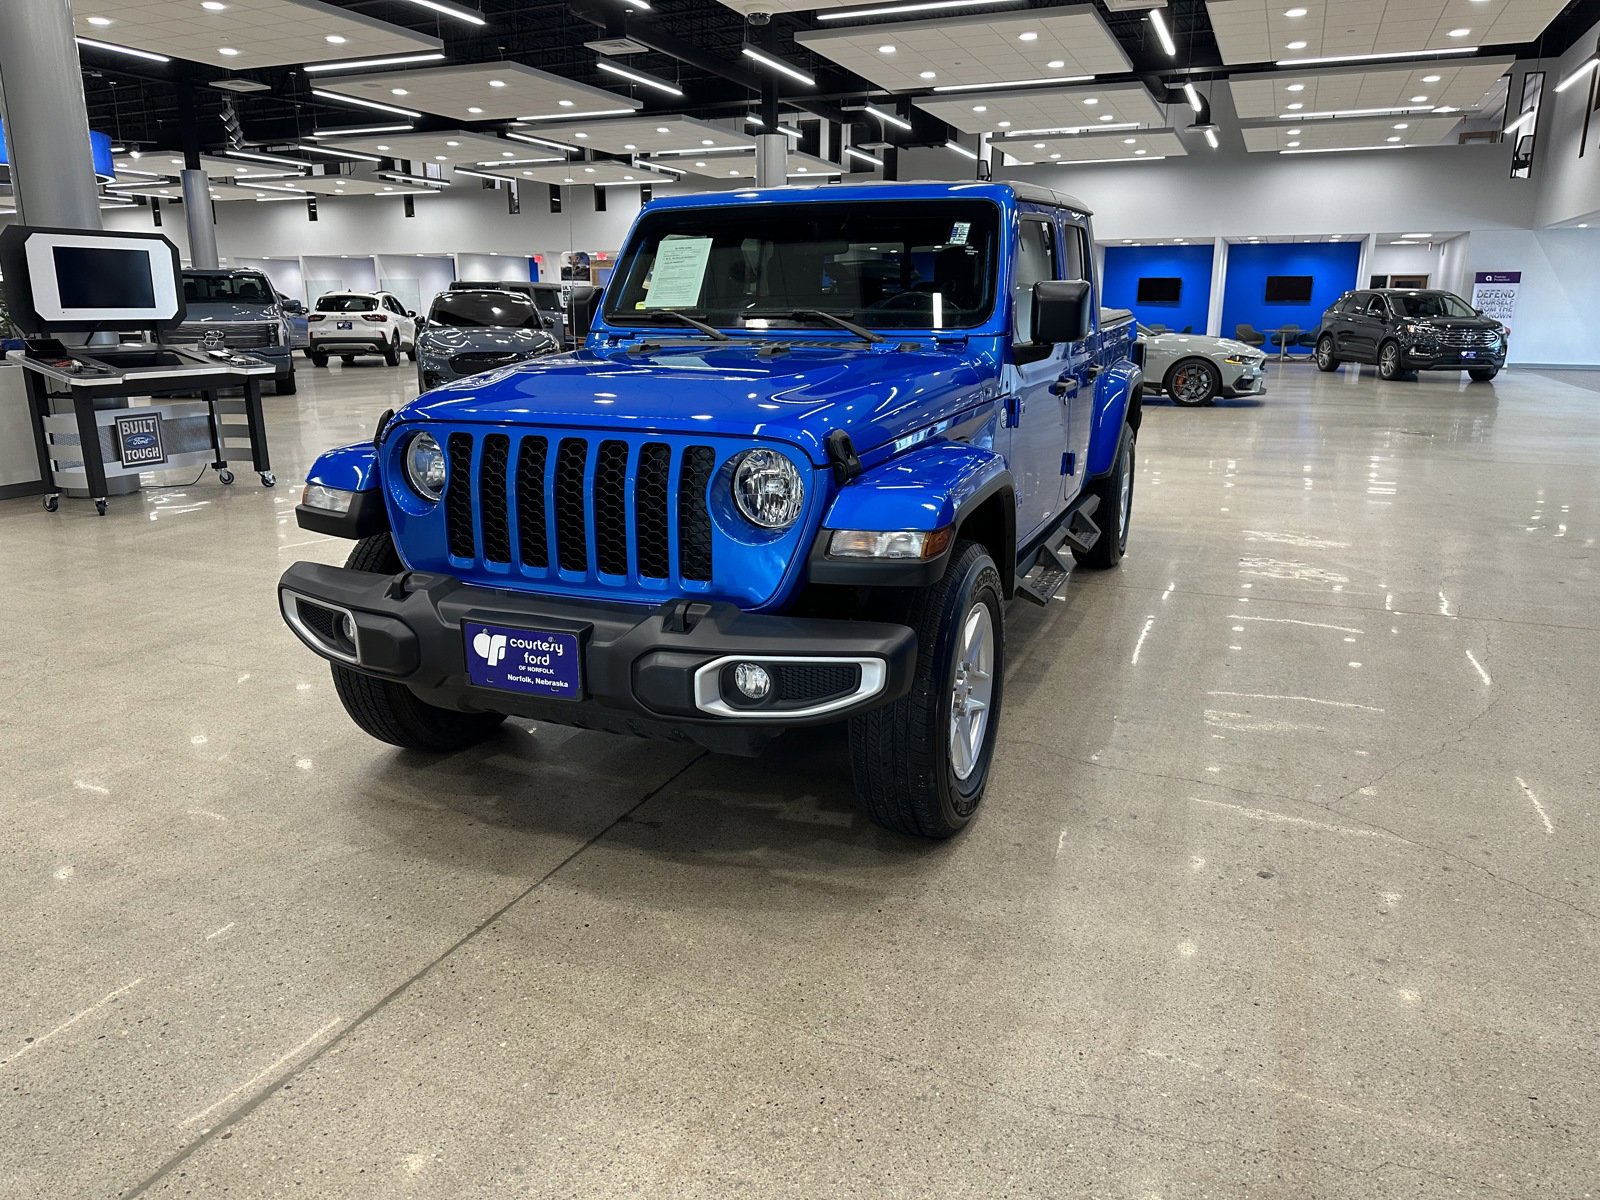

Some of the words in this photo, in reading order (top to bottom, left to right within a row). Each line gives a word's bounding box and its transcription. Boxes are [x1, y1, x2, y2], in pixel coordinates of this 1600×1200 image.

[1476, 290, 1515, 298] DEFEND
[120, 420, 154, 435] BUILT
[126, 446, 159, 461] TOUGH
[510, 638, 564, 656] courtesy
[524, 652, 550, 666] ford
[527, 666, 555, 674] NORFOLK
[507, 674, 534, 685] Norfolk,
[535, 677, 569, 688] Nebraska
